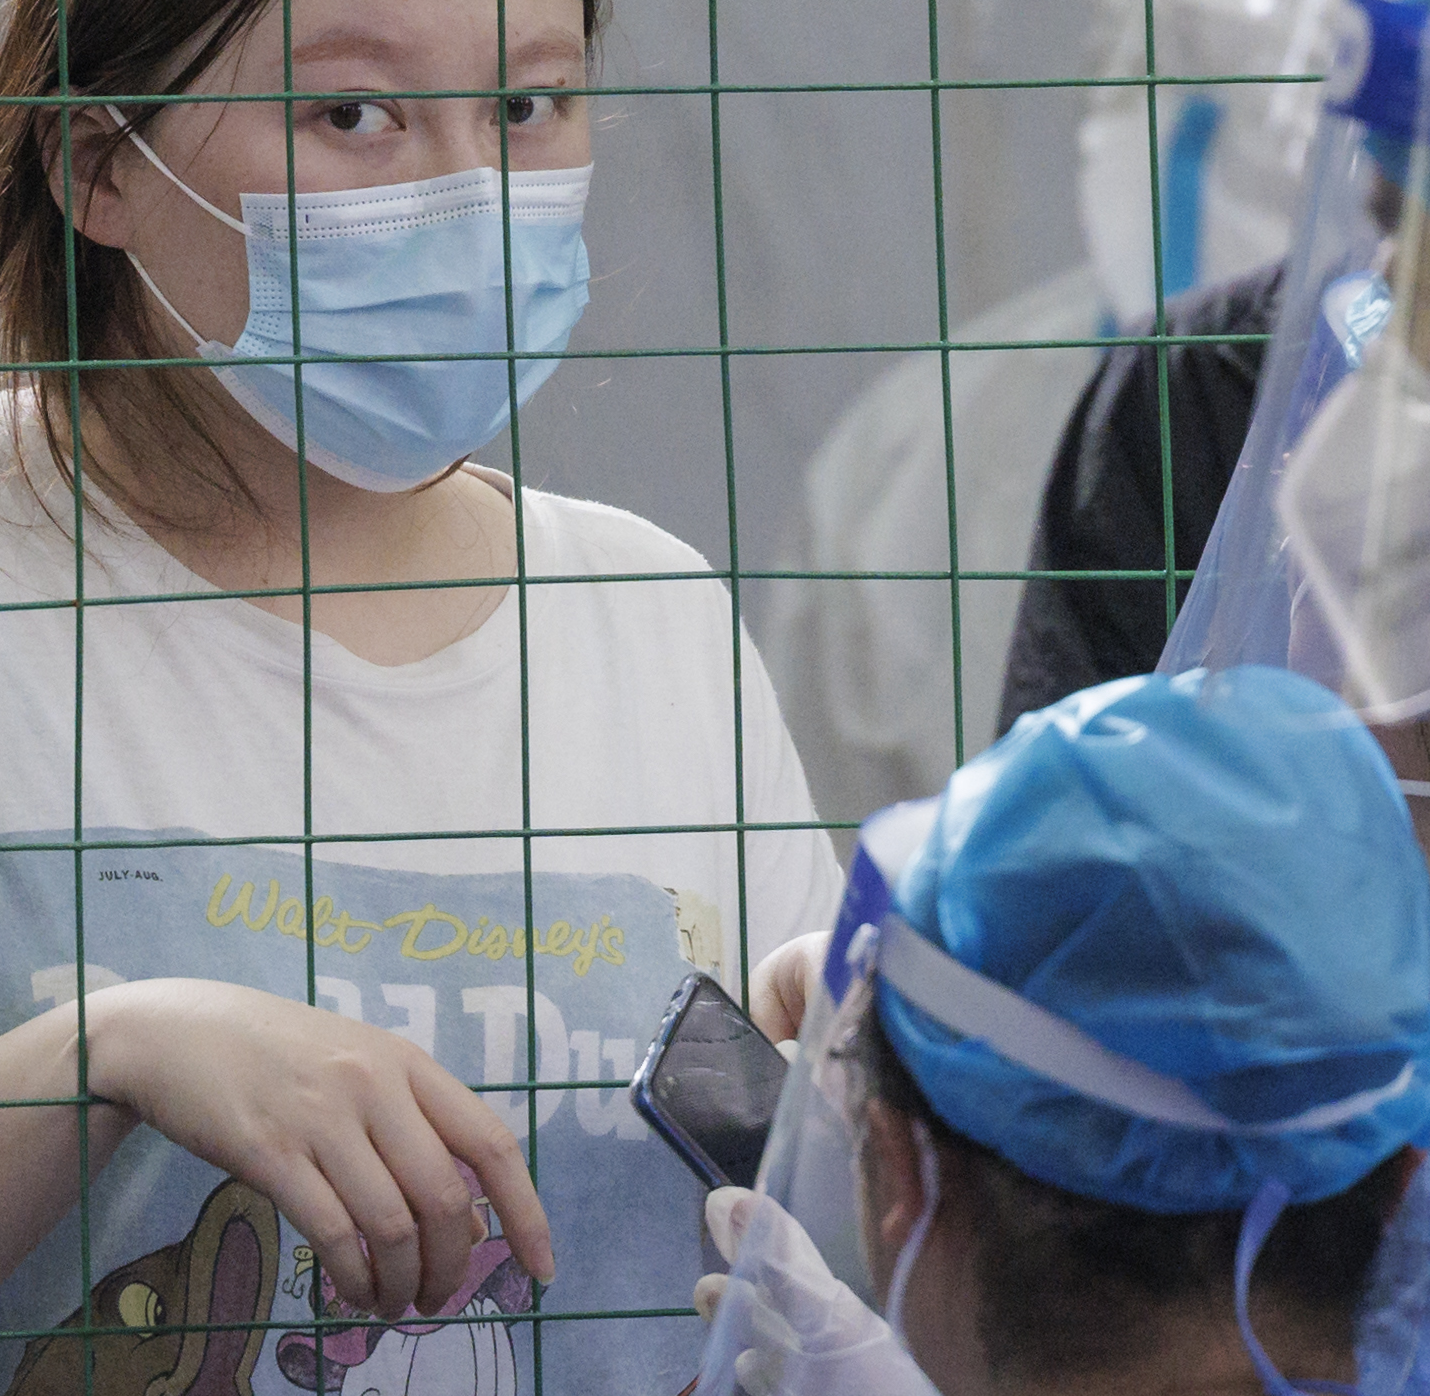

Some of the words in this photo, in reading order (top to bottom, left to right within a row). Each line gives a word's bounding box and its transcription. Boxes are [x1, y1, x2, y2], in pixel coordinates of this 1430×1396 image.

[99, 870, 164, 882] JULY-AUG.
[206, 873, 384, 954] Walt
[383, 903, 626, 977] Disney's
[461, 985, 650, 1142] Du
